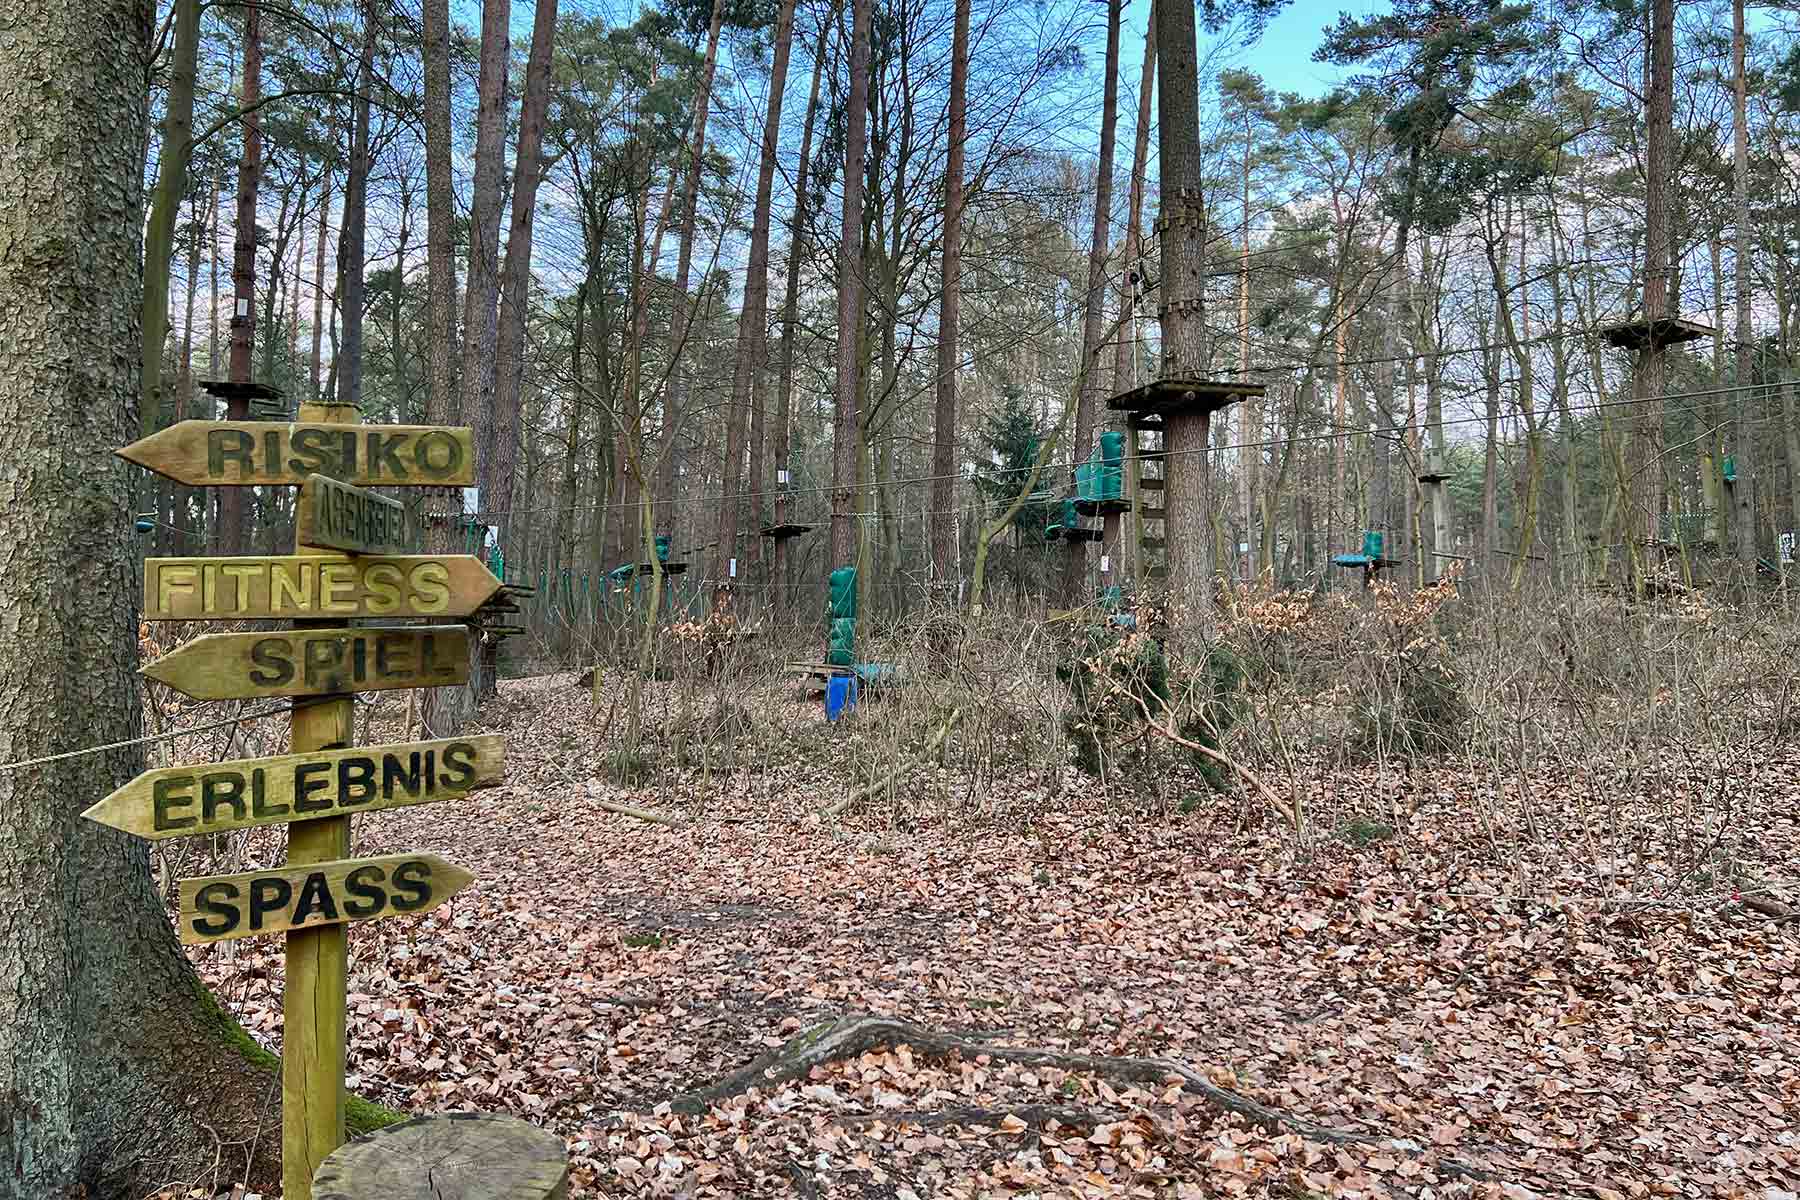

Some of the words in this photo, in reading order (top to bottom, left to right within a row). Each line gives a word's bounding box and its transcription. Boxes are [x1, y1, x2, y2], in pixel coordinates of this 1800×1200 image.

[206, 429, 463, 480] RISIKO
[156, 561, 450, 614] FITNESS
[249, 637, 456, 689] SPIEL
[152, 742, 478, 832] ERLEBNIS
[191, 860, 433, 937] SPASS
